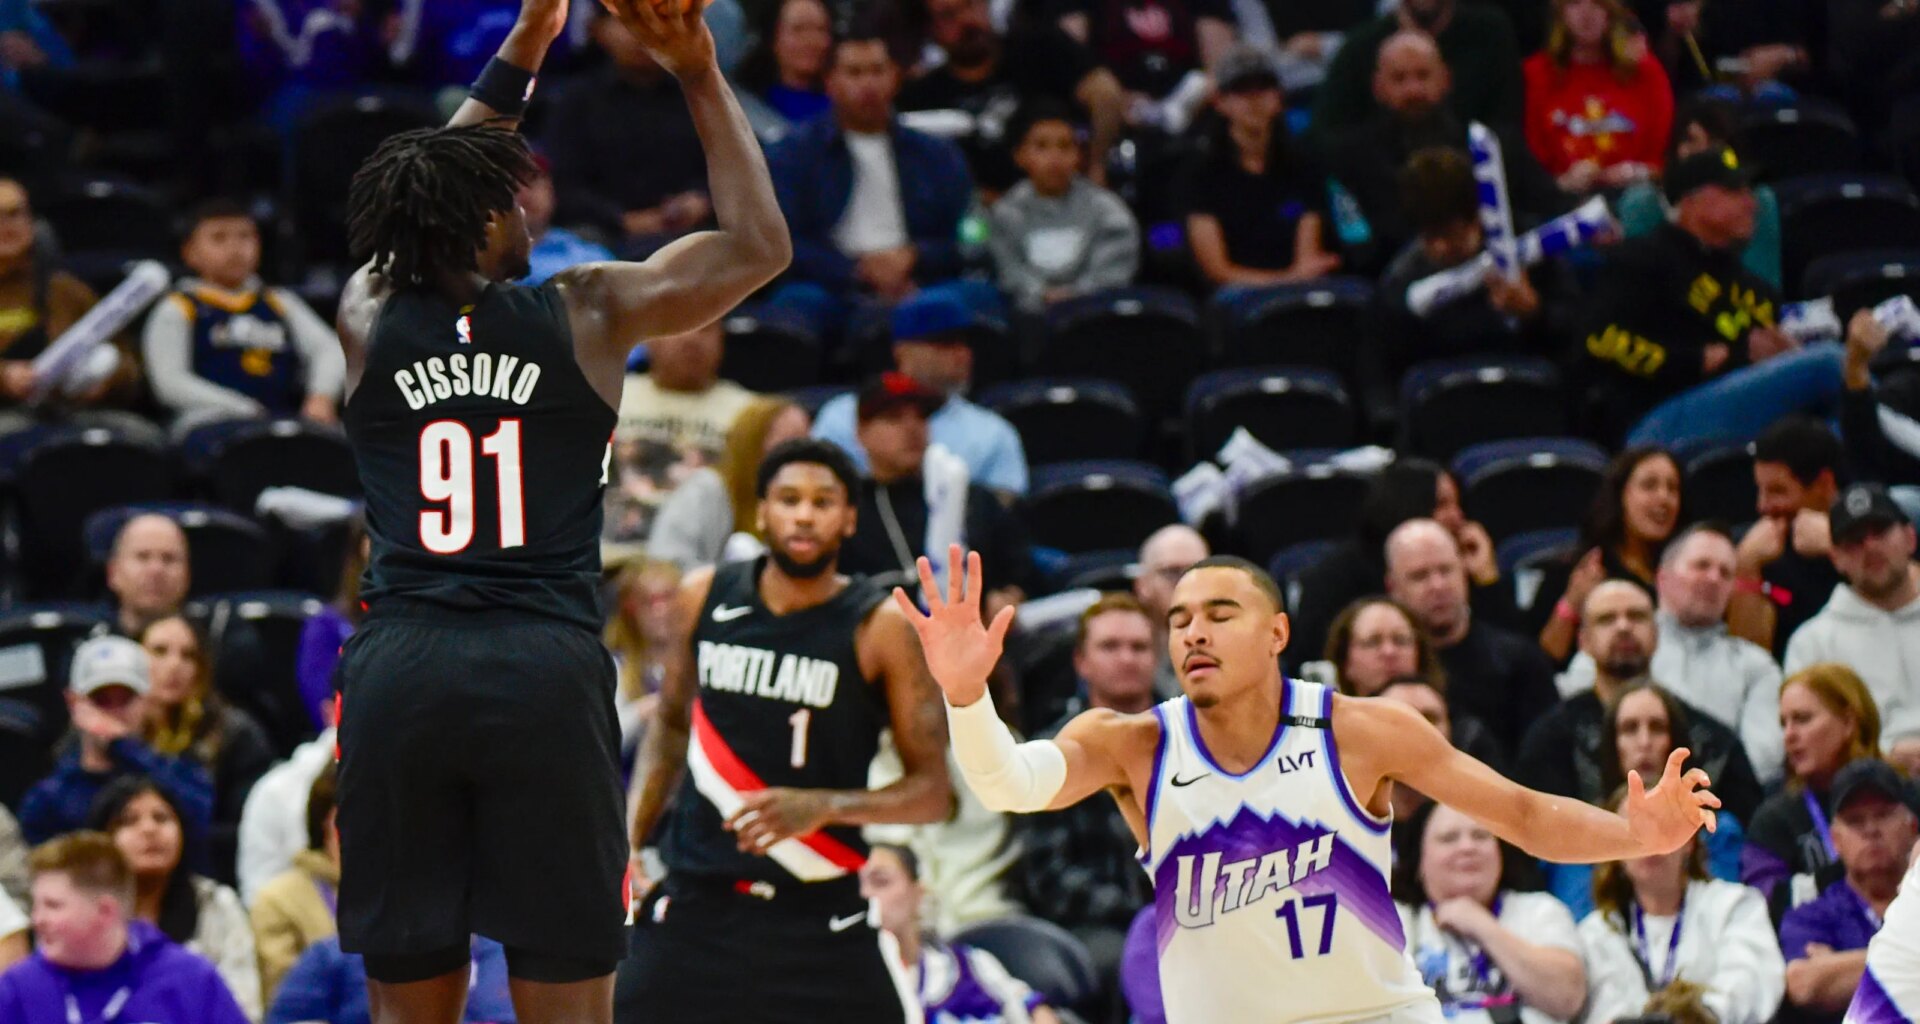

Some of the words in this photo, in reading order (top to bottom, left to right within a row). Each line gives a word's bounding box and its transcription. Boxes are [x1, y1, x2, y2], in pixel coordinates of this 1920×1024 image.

[394, 352, 541, 411] CISSOKO
[418, 418, 526, 555] 91
[698, 640, 839, 708] PORTLAND
[788, 708, 811, 768] 1
[1174, 830, 1338, 930] UTAH
[1275, 893, 1338, 960] 17
